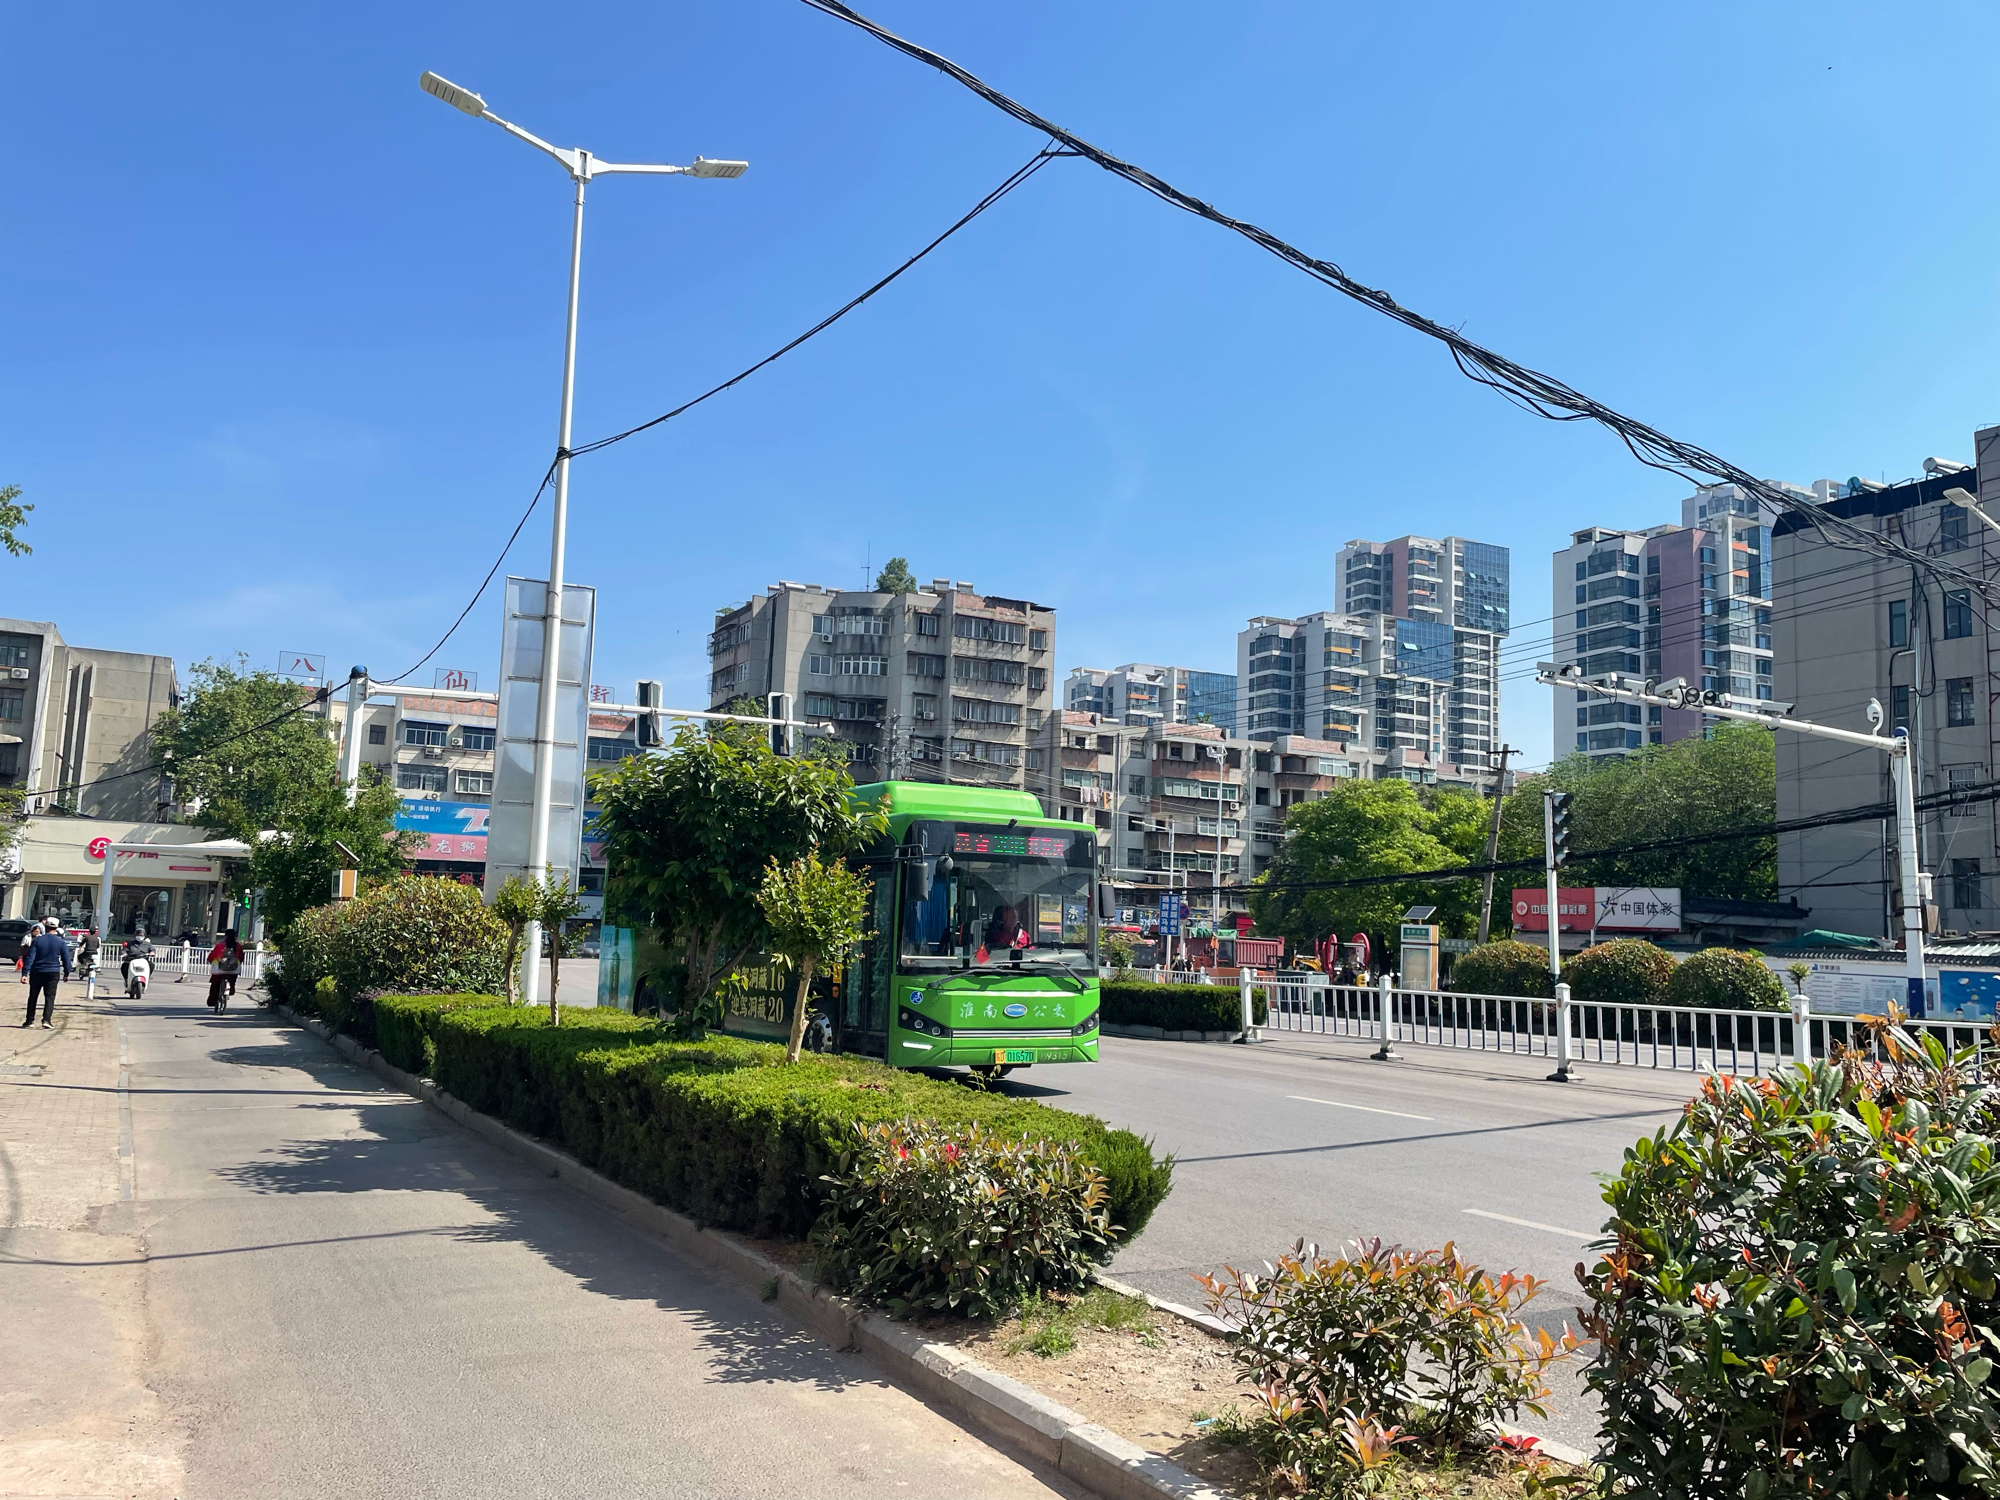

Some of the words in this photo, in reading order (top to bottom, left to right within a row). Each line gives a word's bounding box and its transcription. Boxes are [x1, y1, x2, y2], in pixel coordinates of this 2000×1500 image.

[1530, 904, 1588, 915] 中国利彩票
[1620, 901, 1674, 916] 中国体彩
[960, 1001, 998, 1019] 淮南
